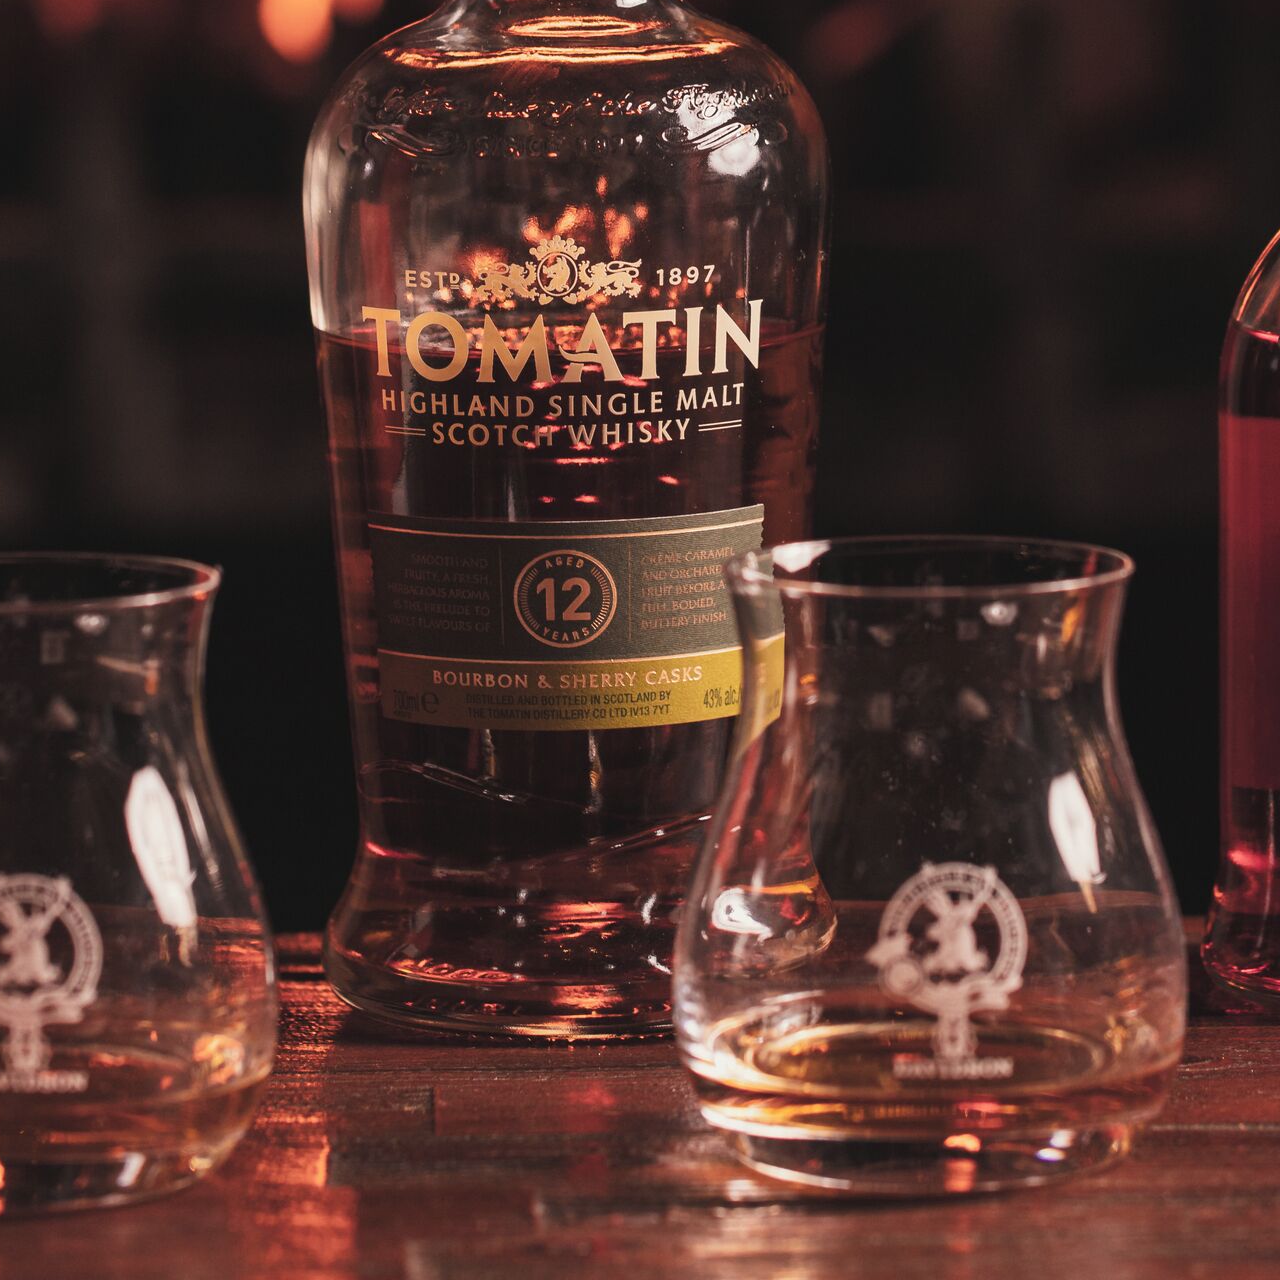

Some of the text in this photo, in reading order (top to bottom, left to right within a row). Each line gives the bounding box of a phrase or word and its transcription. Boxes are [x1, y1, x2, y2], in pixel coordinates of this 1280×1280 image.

[656, 264, 716, 287] 1897
[362, 298, 765, 384] TOMATIN
[382, 382, 746, 418] HIGHLAND SINGLE MALT
[432, 418, 690, 447] SCOTCH WHISKY
[684, 546, 736, 562] CARAMEL
[545, 556, 584, 569] AGED
[642, 570, 668, 581] AND
[642, 580, 726, 598] FRUIT BEFORE A
[536, 576, 592, 622] 12
[474, 606, 490, 617] TO
[692, 611, 726, 626] FINISH
[475, 622, 492, 633] OF
[542, 626, 590, 642] YEARS
[432, 666, 703, 689] BOURBON & SHERRY CASKS
[465, 690, 672, 706] DISTILLED AND BOTTLED IN SCOTLAND BY
[704, 688, 722, 709] 43%
[467, 704, 670, 720] THE TOMATIN DISTILLERY CO LTD IV13 7YT
